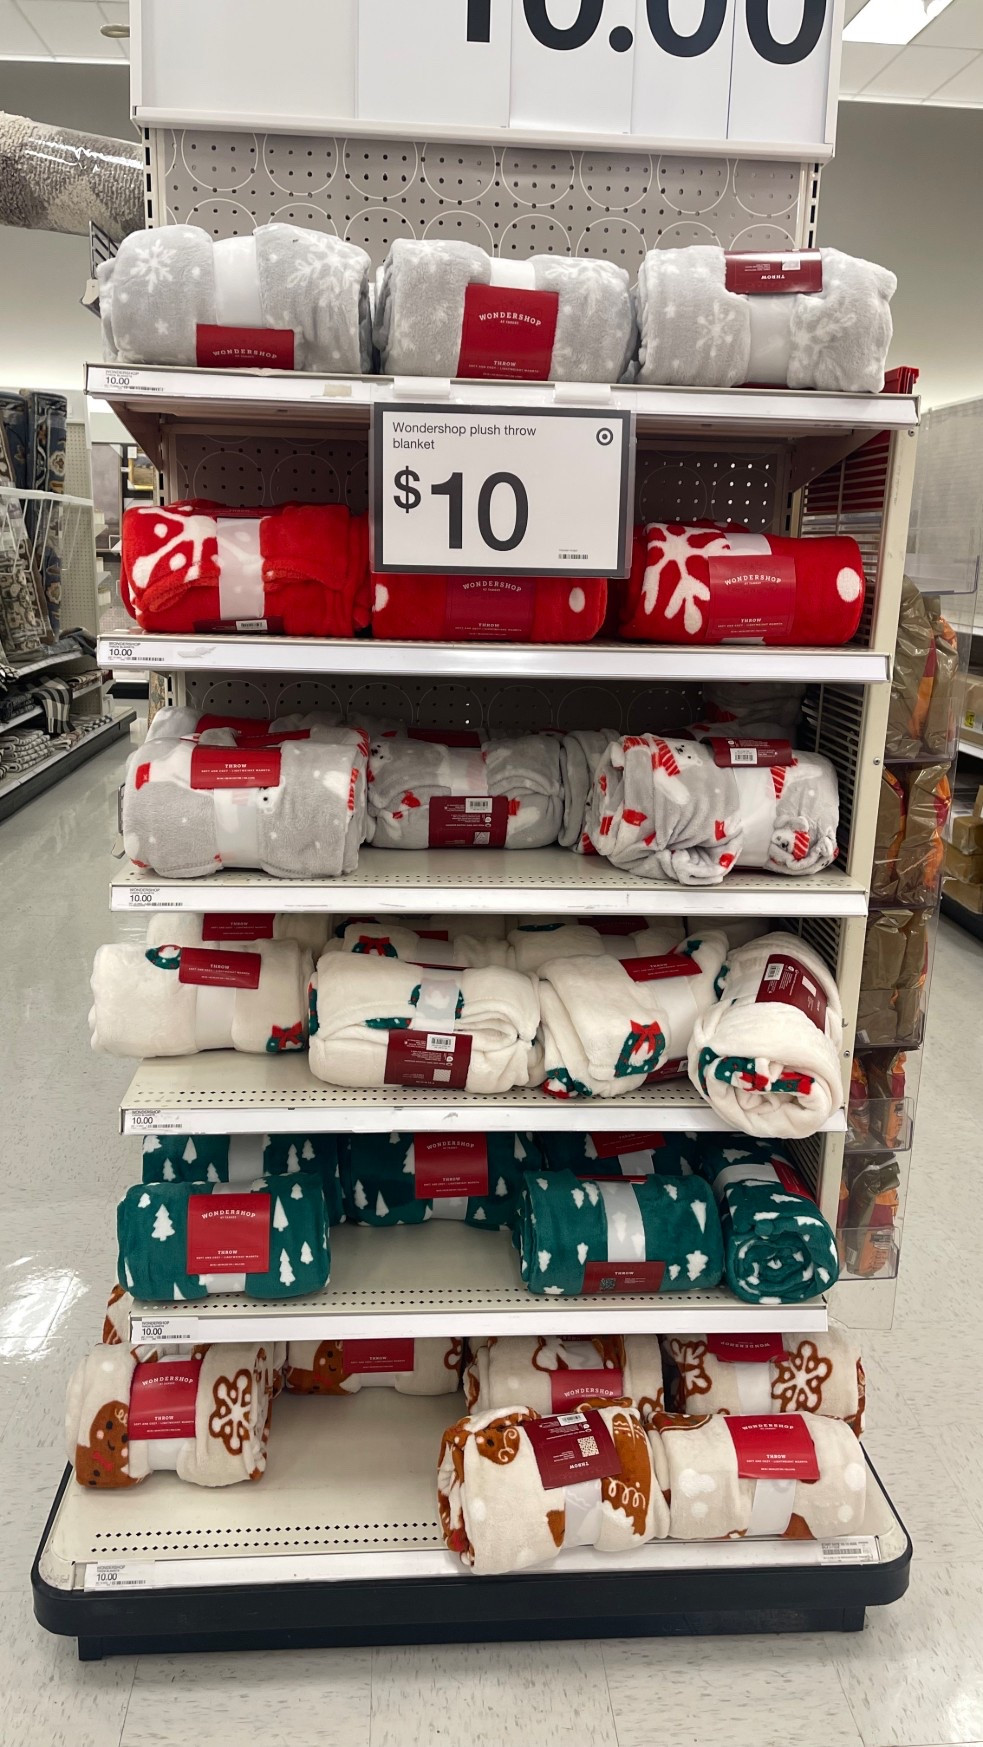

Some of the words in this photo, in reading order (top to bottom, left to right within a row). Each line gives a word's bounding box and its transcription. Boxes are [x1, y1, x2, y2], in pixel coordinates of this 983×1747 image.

[479, 312, 542, 327] WONDERSHOP
[213, 348, 277, 359] WONDERSHOP
[106, 376, 130, 385] 10.00
[392, 421, 467, 436] Wondershop
[469, 423, 501, 437] plush
[504, 424, 537, 436] throw
[392, 437, 435, 450] blanket
[393, 465, 529, 551] $10
[724, 574, 782, 586] WONDERSHOP
[462, 580, 522, 593] WONDERSHOP
[109, 648, 133, 657] 10.00
[129, 894, 153, 902] 10.00
[132, 1116, 154, 1125] 10.00
[426, 1140, 475, 1150] WONDERSHOP
[201, 1209, 256, 1219] WONDERSHOP
[142, 1327, 163, 1336] 10.00
[142, 1376, 194, 1386] WONDERSHOP
[564, 1387, 614, 1397] WONDERSHOP
[569, 1461, 589, 1470] THROW
[97, 1572, 118, 1581] 10.00
